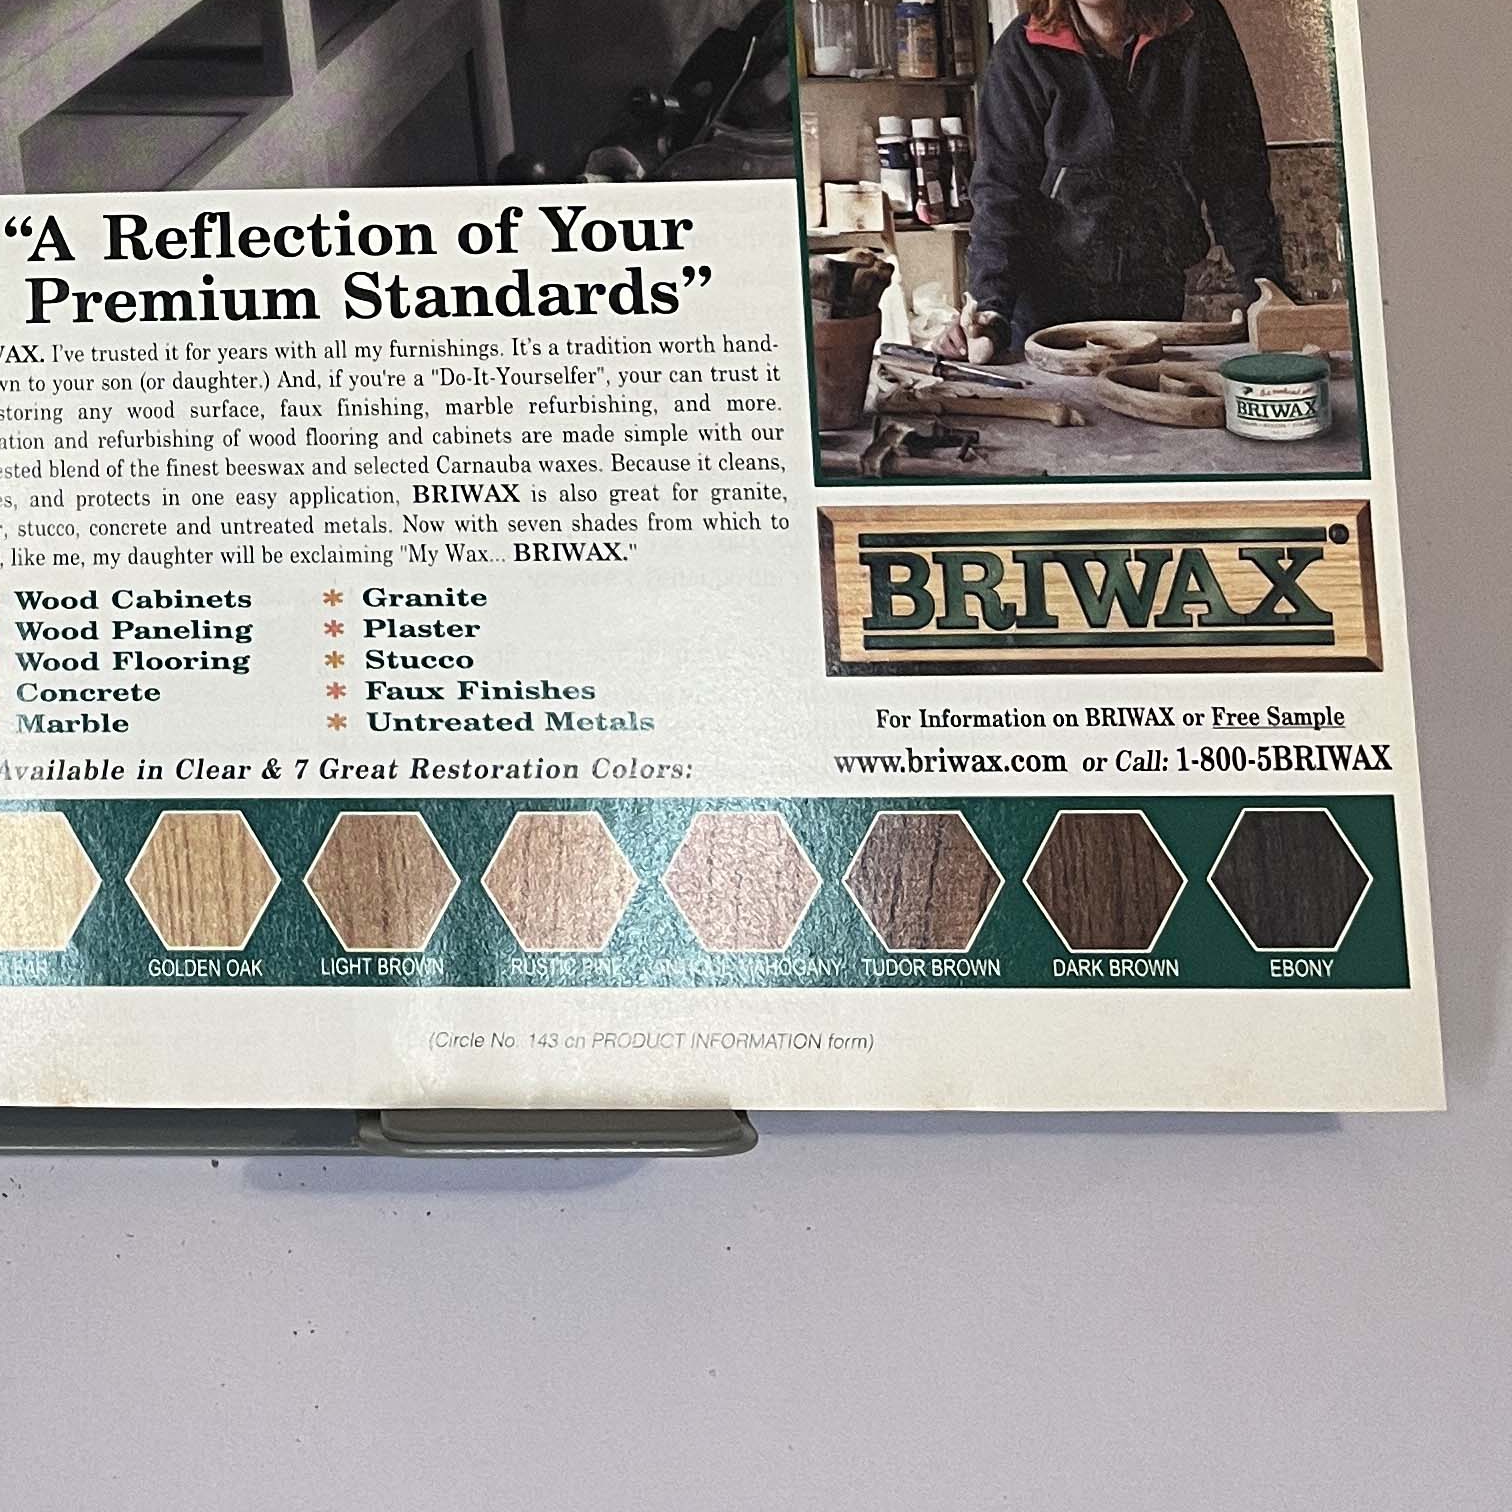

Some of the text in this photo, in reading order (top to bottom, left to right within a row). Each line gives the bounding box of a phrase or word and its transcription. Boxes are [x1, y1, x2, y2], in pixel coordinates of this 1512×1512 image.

[5, 206, 693, 261] "A Reflection of Your
[25, 266, 711, 323] Premium Standards"
[77, 406, 113, 425] any
[126, 399, 176, 420] wood
[189, 398, 265, 422] surface,
[280, 397, 323, 418] faux
[337, 396, 430, 420] finishing,
[445, 395, 514, 416] marble
[528, 393, 658, 418] refurbishing,
[673, 392, 712, 413] and
[726, 397, 782, 412] more.
[1237, 400, 1316, 417] BRIWAX
[12, 588, 252, 611] Wood Cabinets
[362, 587, 488, 608] Granite
[859, 547, 1332, 631] BRIWAX
[14, 619, 254, 644] Wood Paneling
[362, 618, 481, 639] Plaster
[14, 650, 251, 676] Wood Flooring
[365, 649, 475, 670] Stucco
[16, 682, 161, 703] Concrete
[364, 679, 596, 701] Faux Finishes
[15, 712, 129, 735] Marble
[365, 710, 656, 733] Untreated Metals
[875, 706, 1345, 731] For Information on BRIWAX or Free Sample
[832, 743, 1393, 774] www.briwax.com or Call: 1-800-5BRIWAX
[148, 958, 264, 978] GOLDEN OAK
[320, 956, 445, 977] LIGHT BROWN
[860, 957, 1001, 978] TUDOR BROWN
[1052, 958, 1180, 977] DARK BROWN
[1270, 958, 1334, 978] EBONY
